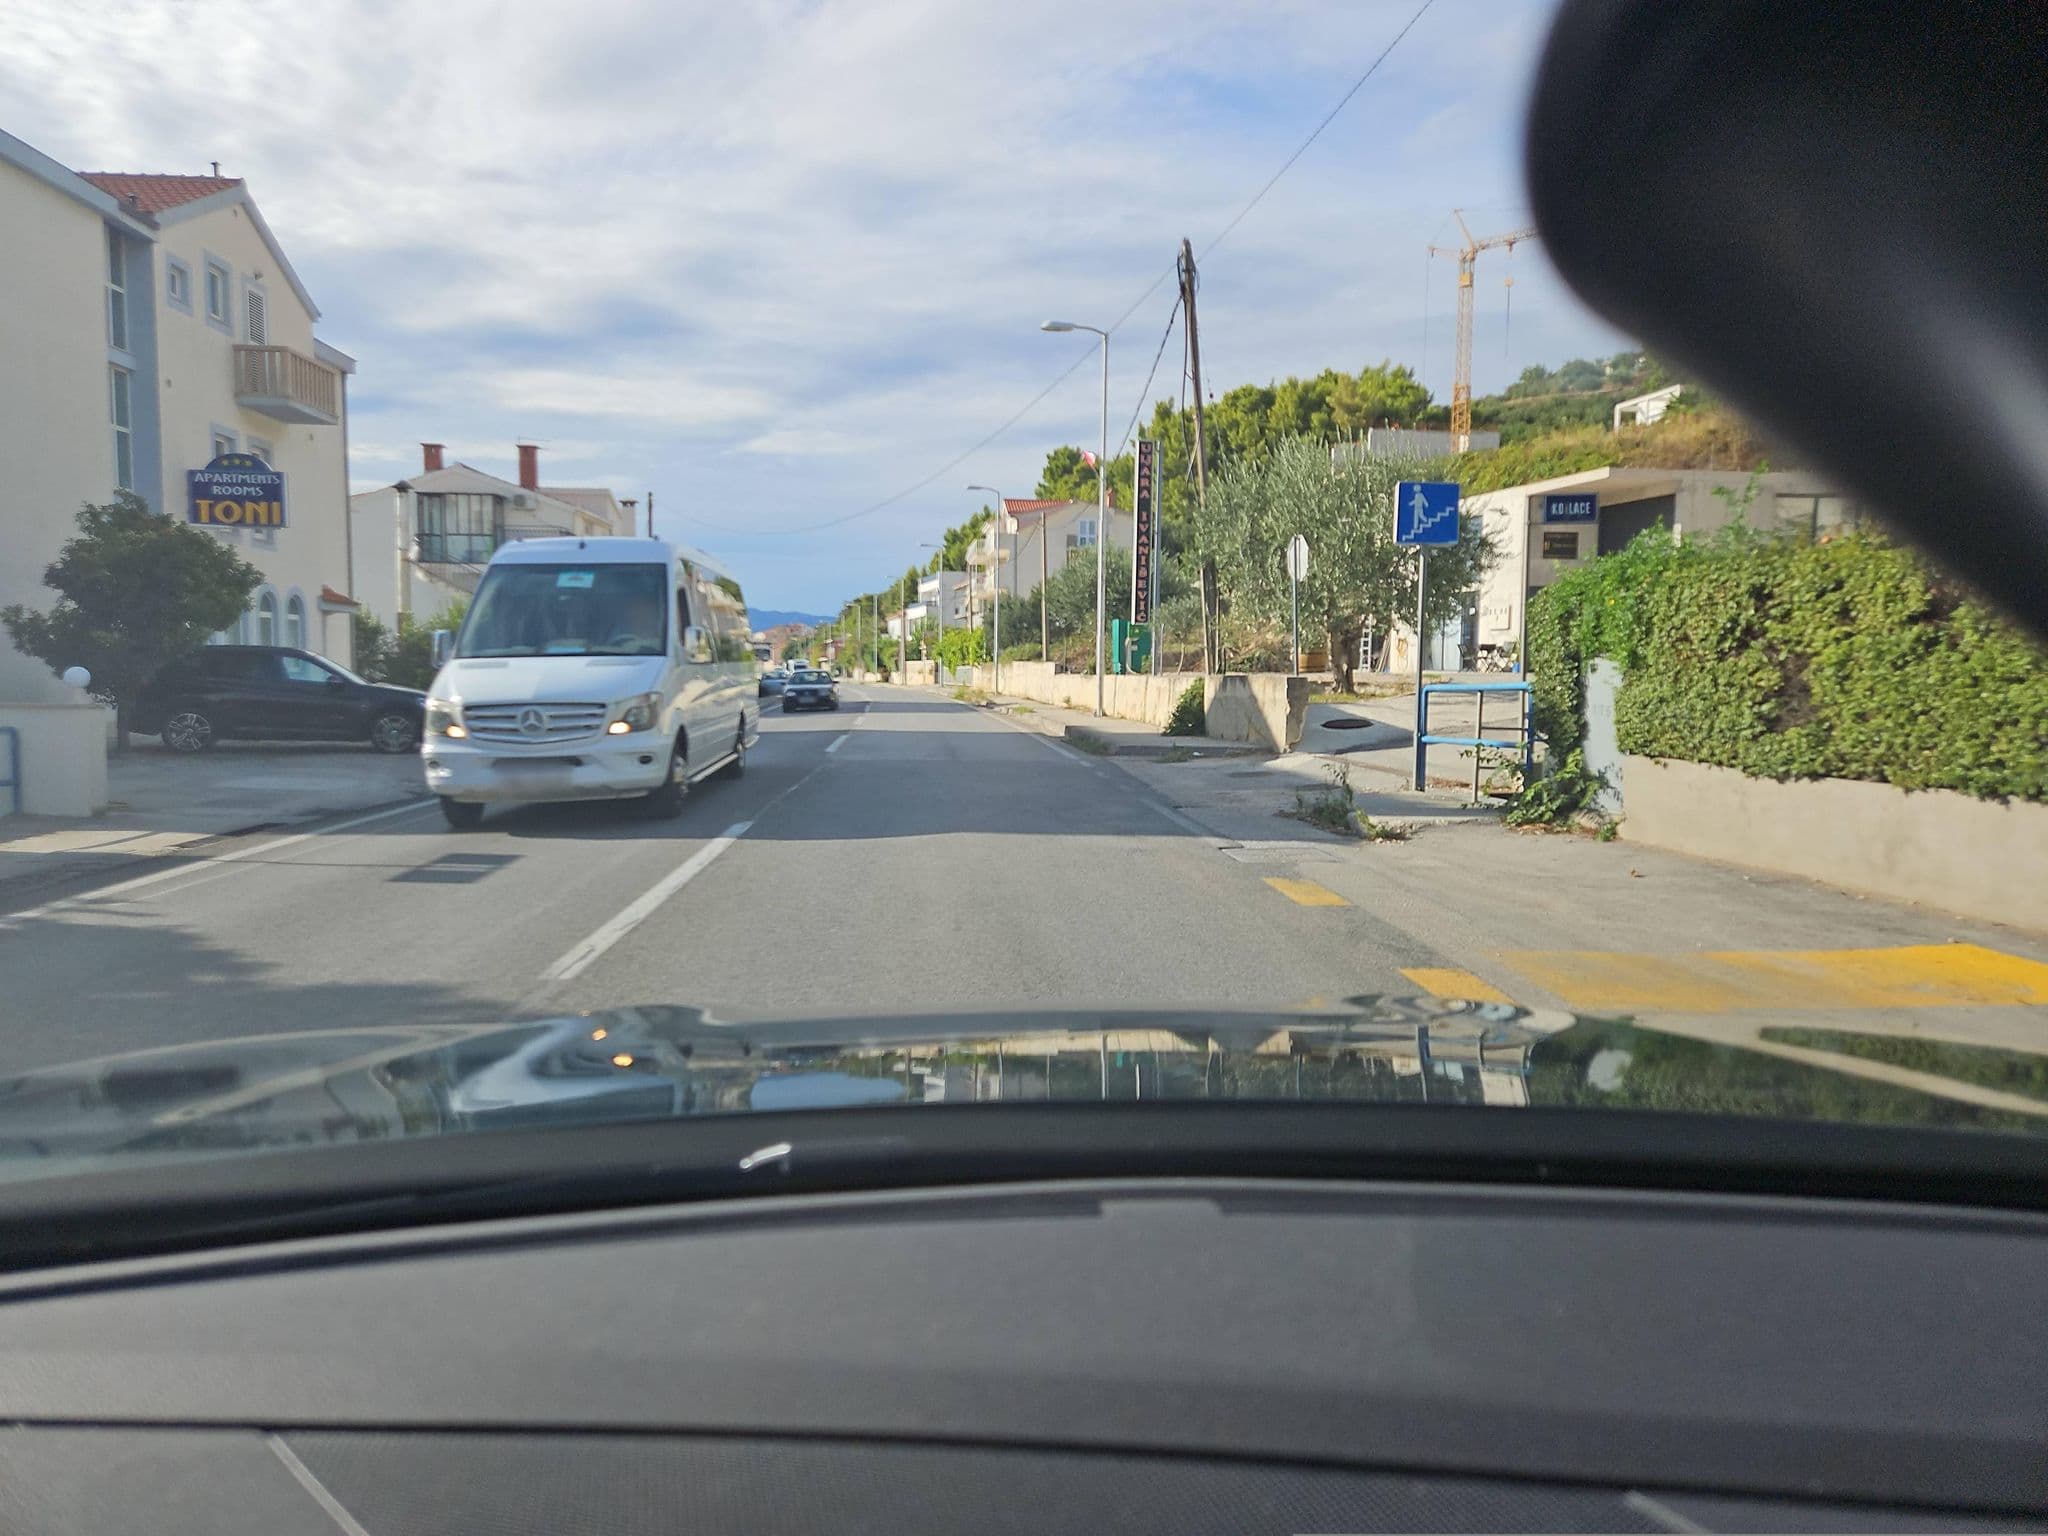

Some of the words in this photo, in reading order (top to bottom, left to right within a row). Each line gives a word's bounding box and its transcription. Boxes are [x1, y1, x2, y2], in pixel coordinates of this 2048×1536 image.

[195, 473, 280, 484] APARTMENTS
[213, 485, 264, 496] ROOMS
[195, 499, 281, 525] TONI
